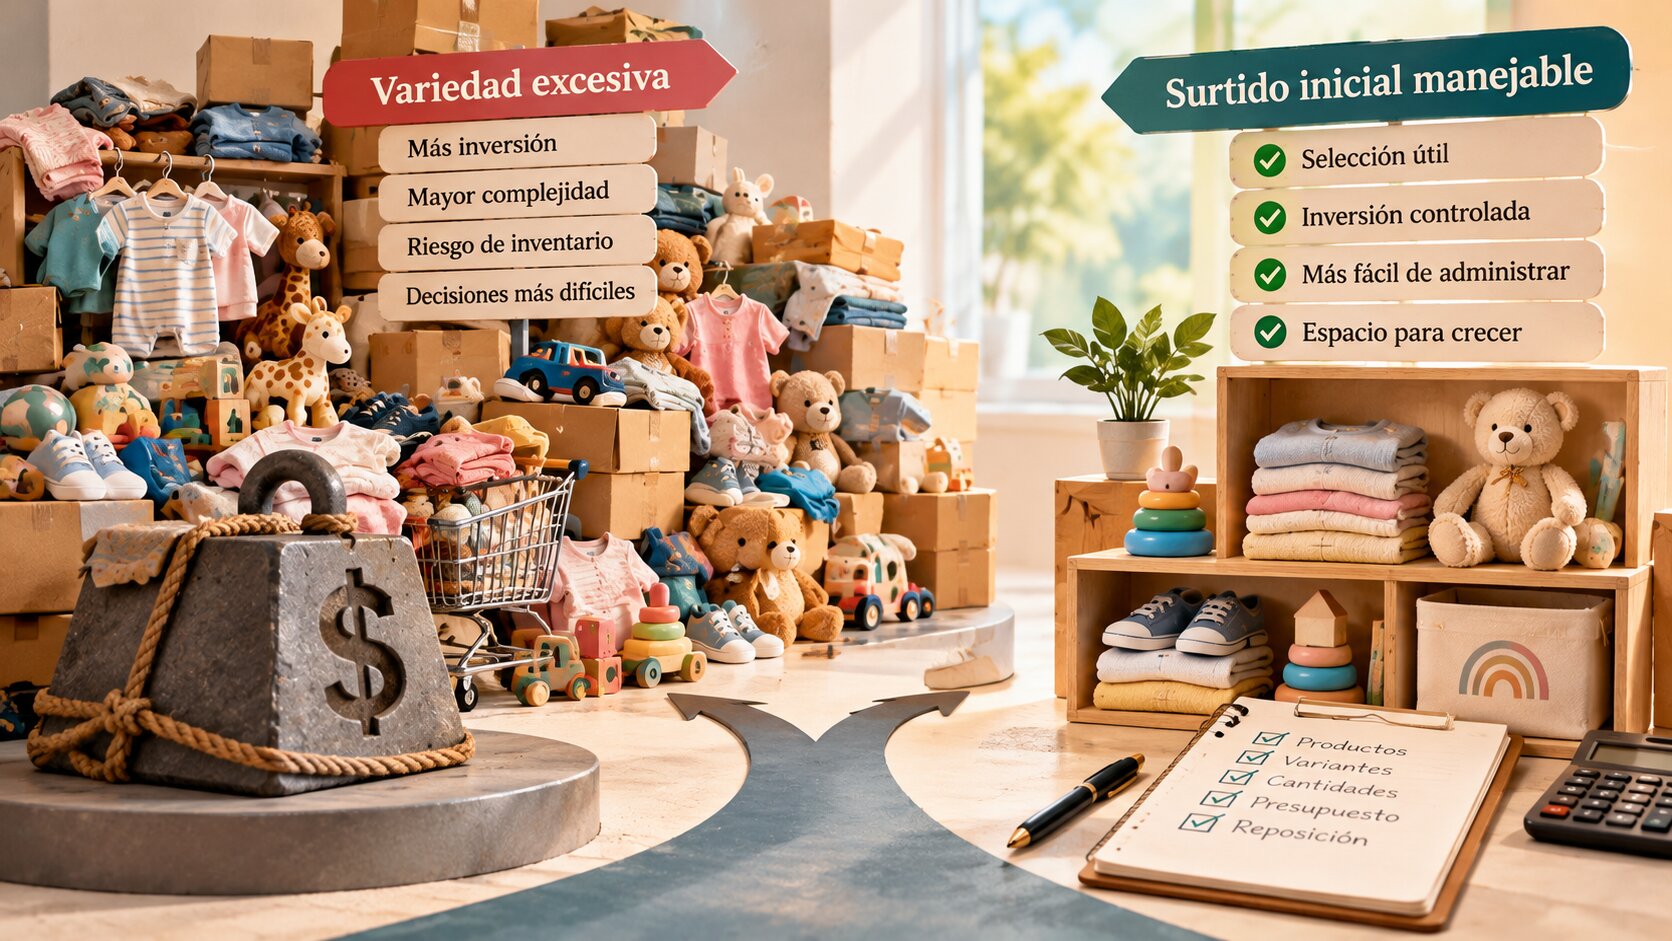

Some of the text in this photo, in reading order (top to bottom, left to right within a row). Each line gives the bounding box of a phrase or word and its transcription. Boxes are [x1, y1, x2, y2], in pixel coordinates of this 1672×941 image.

[371, 63, 670, 104] Variedad excesiva
[1166, 53, 1593, 108] Surtido inicial manejable
[408, 133, 557, 158] Más inversión
[1302, 143, 1449, 169] Selección útil
[408, 180, 609, 211] Mayor complejidad
[1302, 200, 1530, 226] Inversión controlada
[408, 231, 613, 260] Riesgo de inventario
[1303, 261, 1570, 284] Más fácil de administrar
[406, 281, 635, 305] Decisiones más difíciles
[1303, 322, 1522, 347] Espacio para crecer
[318, 566, 407, 737] $
[1297, 737, 1407, 756] Productos
[1286, 756, 1392, 775] Variantes
[1267, 776, 1397, 798] Cantidades
[1251, 797, 1399, 822] Presupuesto
[1232, 818, 1369, 846] Reposición
